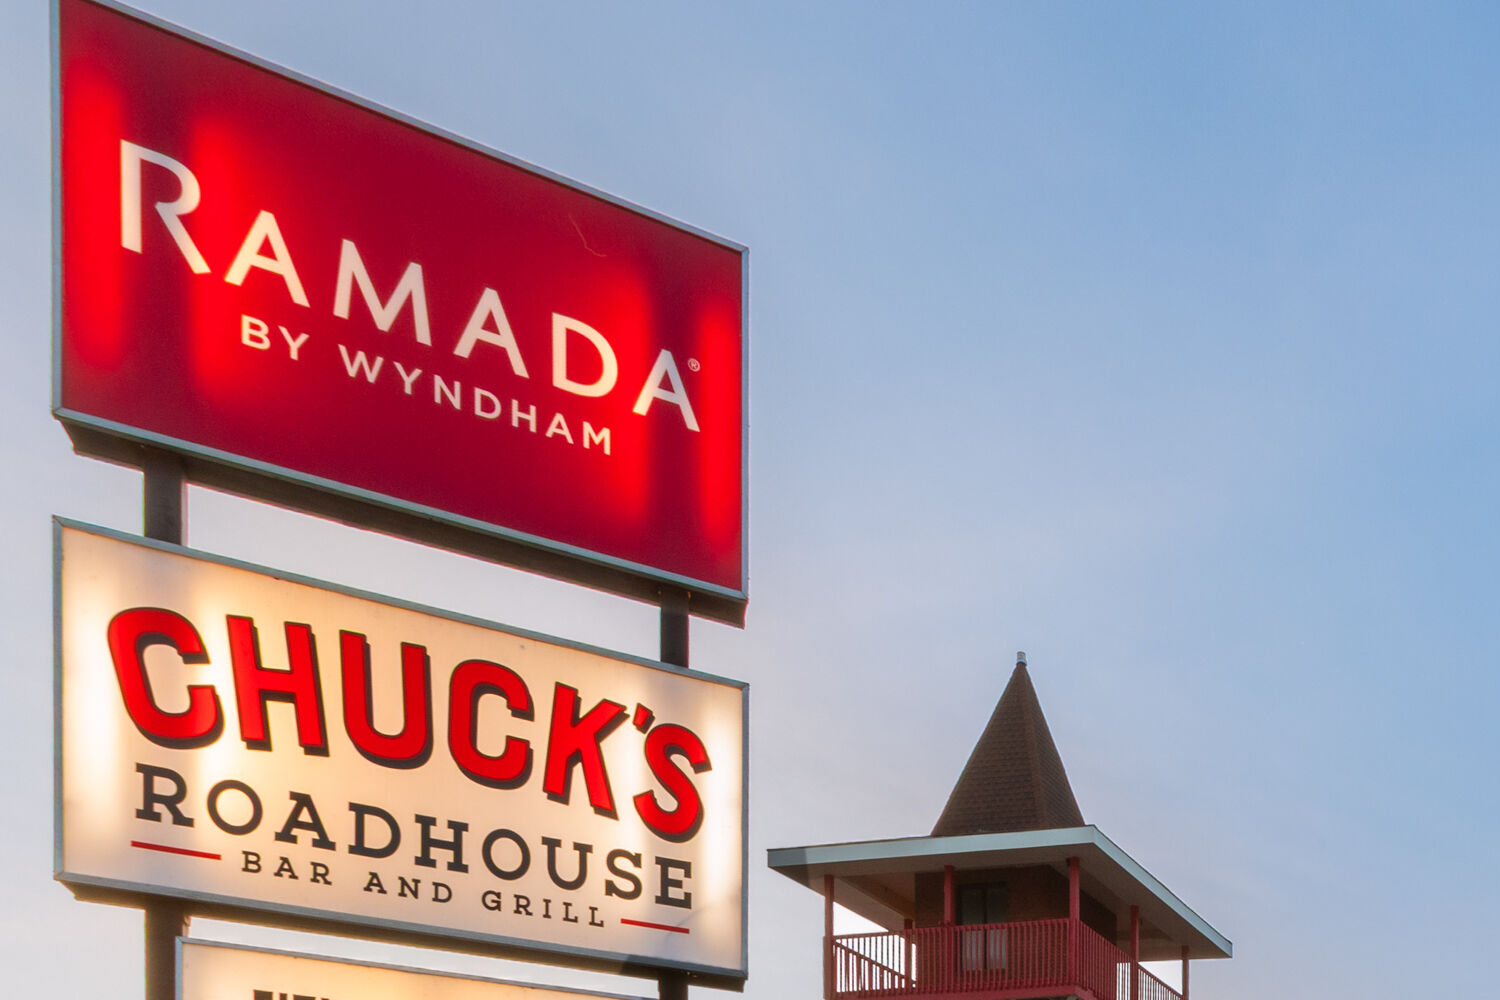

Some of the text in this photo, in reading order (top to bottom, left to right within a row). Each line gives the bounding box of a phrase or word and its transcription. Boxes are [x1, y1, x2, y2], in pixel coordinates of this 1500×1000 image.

[240, 315, 612, 456] BY WYNDHAM
[107, 606, 713, 844] CHUCK'S
[135, 762, 693, 910] ROADHOUSE
[241, 850, 606, 929] BAR AND GRILL
